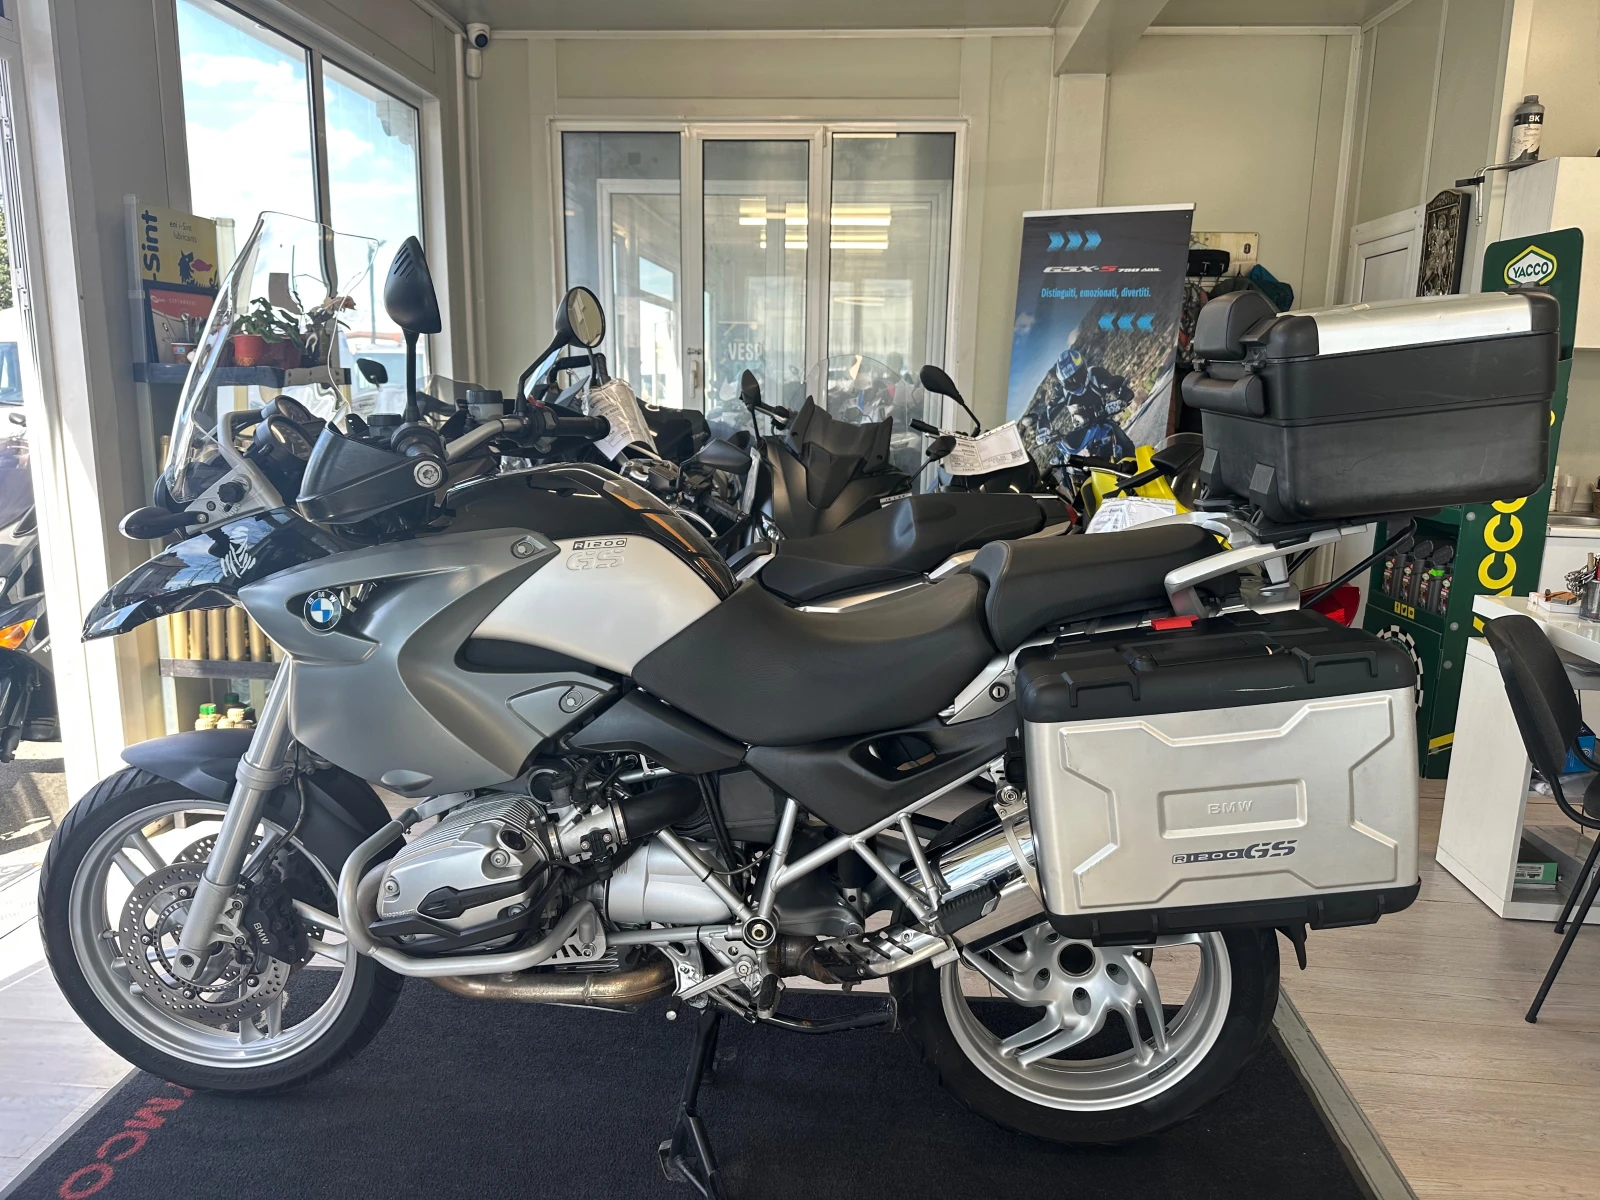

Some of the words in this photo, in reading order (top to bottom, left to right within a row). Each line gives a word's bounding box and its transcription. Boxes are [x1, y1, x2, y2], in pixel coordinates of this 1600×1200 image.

[172, 230, 199, 244] lubricants
[1512, 261, 1550, 279] YACCO
[1041, 288, 1078, 300] Distinguiti,
[1079, 287, 1119, 299] emozionati,
[1120, 286, 1151, 298] divertiti.
[573, 538, 627, 550] R1200
[566, 549, 625, 570] GS
[307, 591, 338, 605] BMW
[1207, 800, 1253, 814] BMW
[253, 922, 270, 945] BMW
